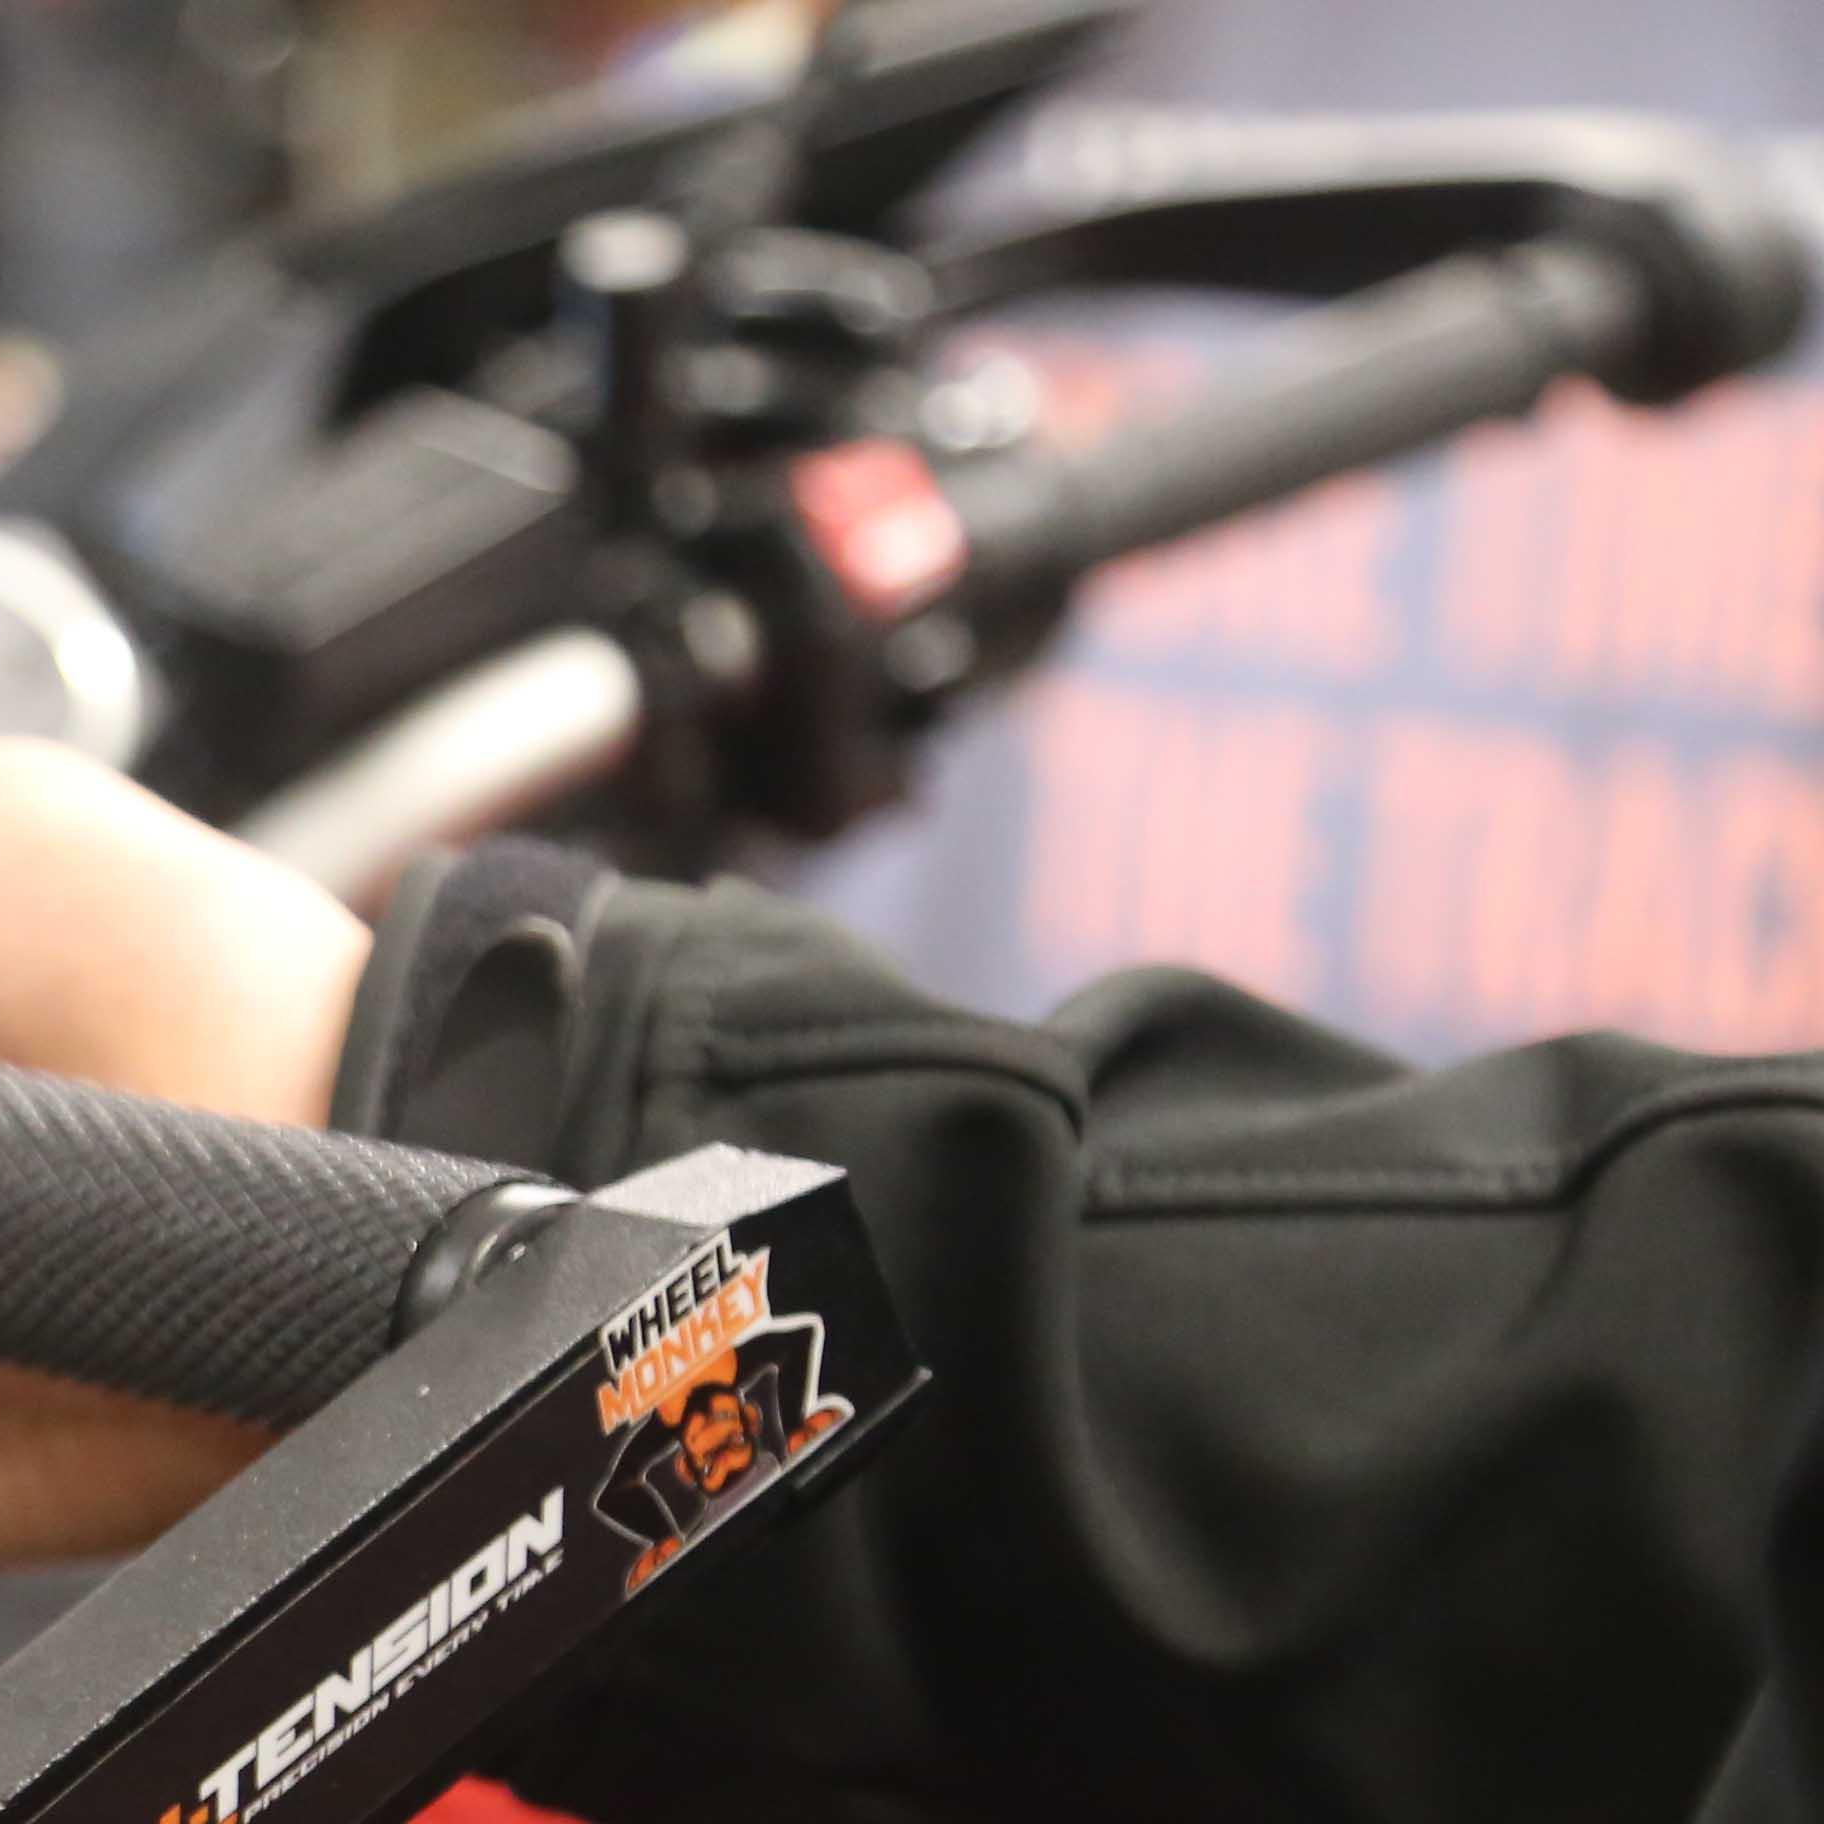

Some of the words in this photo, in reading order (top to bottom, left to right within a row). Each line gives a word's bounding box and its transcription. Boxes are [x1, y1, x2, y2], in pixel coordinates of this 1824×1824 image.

[598, 1255, 768, 1434] MONKEY
[607, 1244, 742, 1374] WHEEL
[395, 1610, 489, 1698] EVERY
[496, 1548, 564, 1613] TIME
